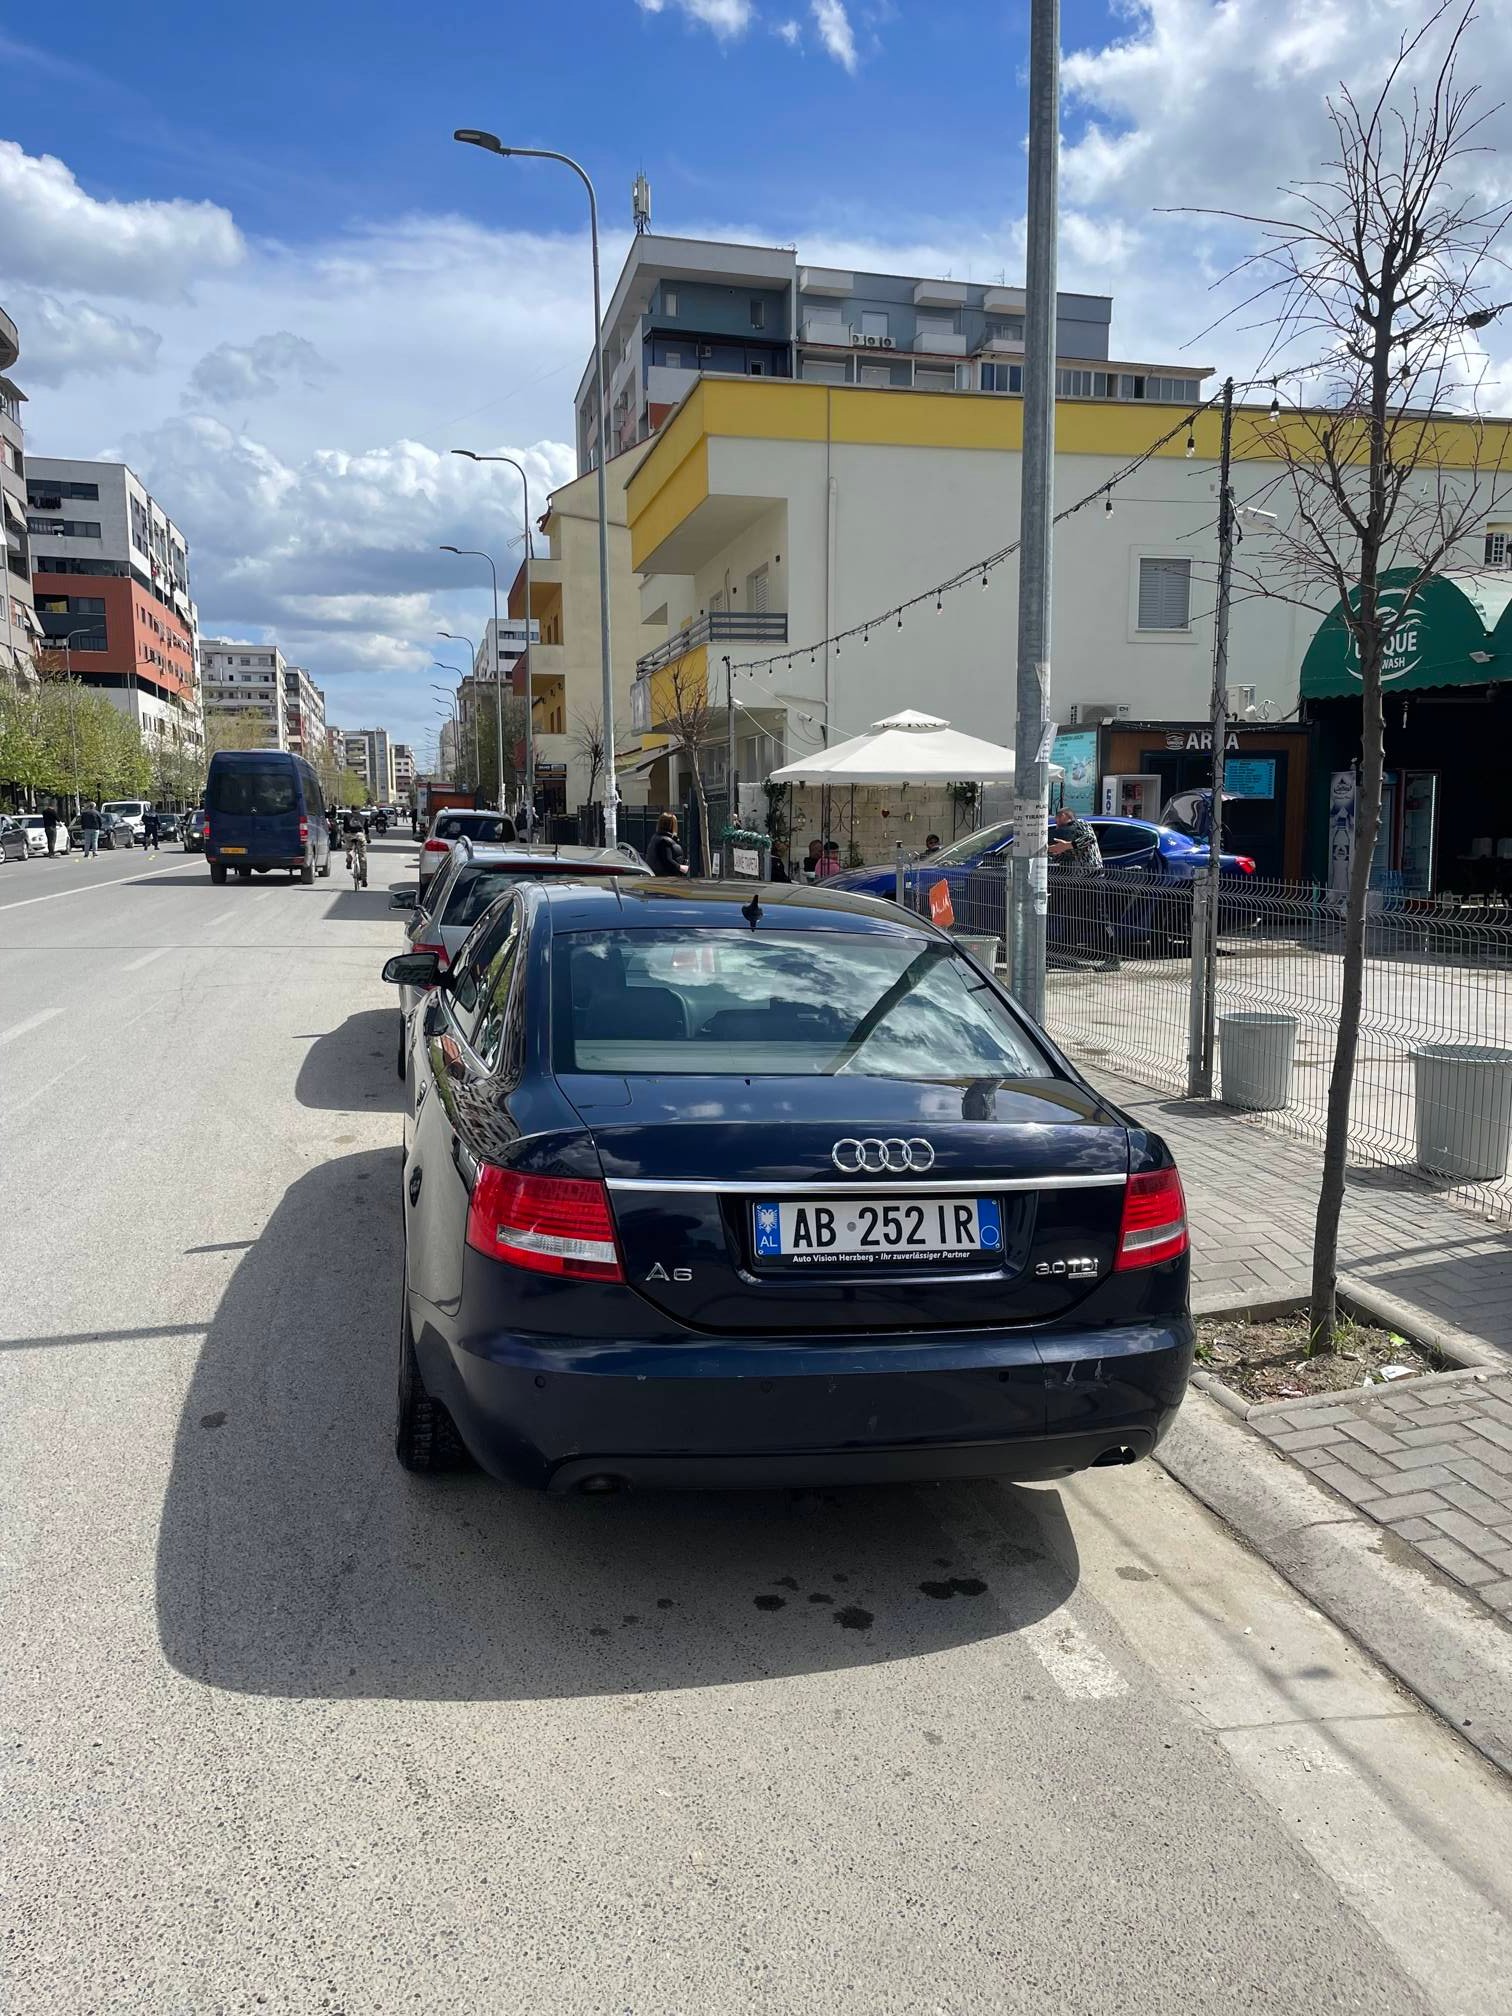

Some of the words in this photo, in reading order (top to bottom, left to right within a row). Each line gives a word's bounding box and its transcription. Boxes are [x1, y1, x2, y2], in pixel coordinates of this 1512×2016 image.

[1354, 631, 1417, 660] UQUE
[1186, 732, 1240, 750] ARA
[793, 1207, 837, 1248] AB
[858, 1205, 926, 1246] 252
[938, 1204, 976, 1244] IR
[760, 1235, 778, 1247] AL
[792, 1254, 812, 1263] Auto
[812, 1254, 838, 1262] Vision
[838, 1253, 874, 1262] Herzberg
[892, 1251, 941, 1262] zuverlässiger
[942, 1251, 971, 1259] Partner
[1035, 1260, 1066, 1276] 3.0
[1067, 1257, 1099, 1272] TDI
[645, 1261, 693, 1282] A6
